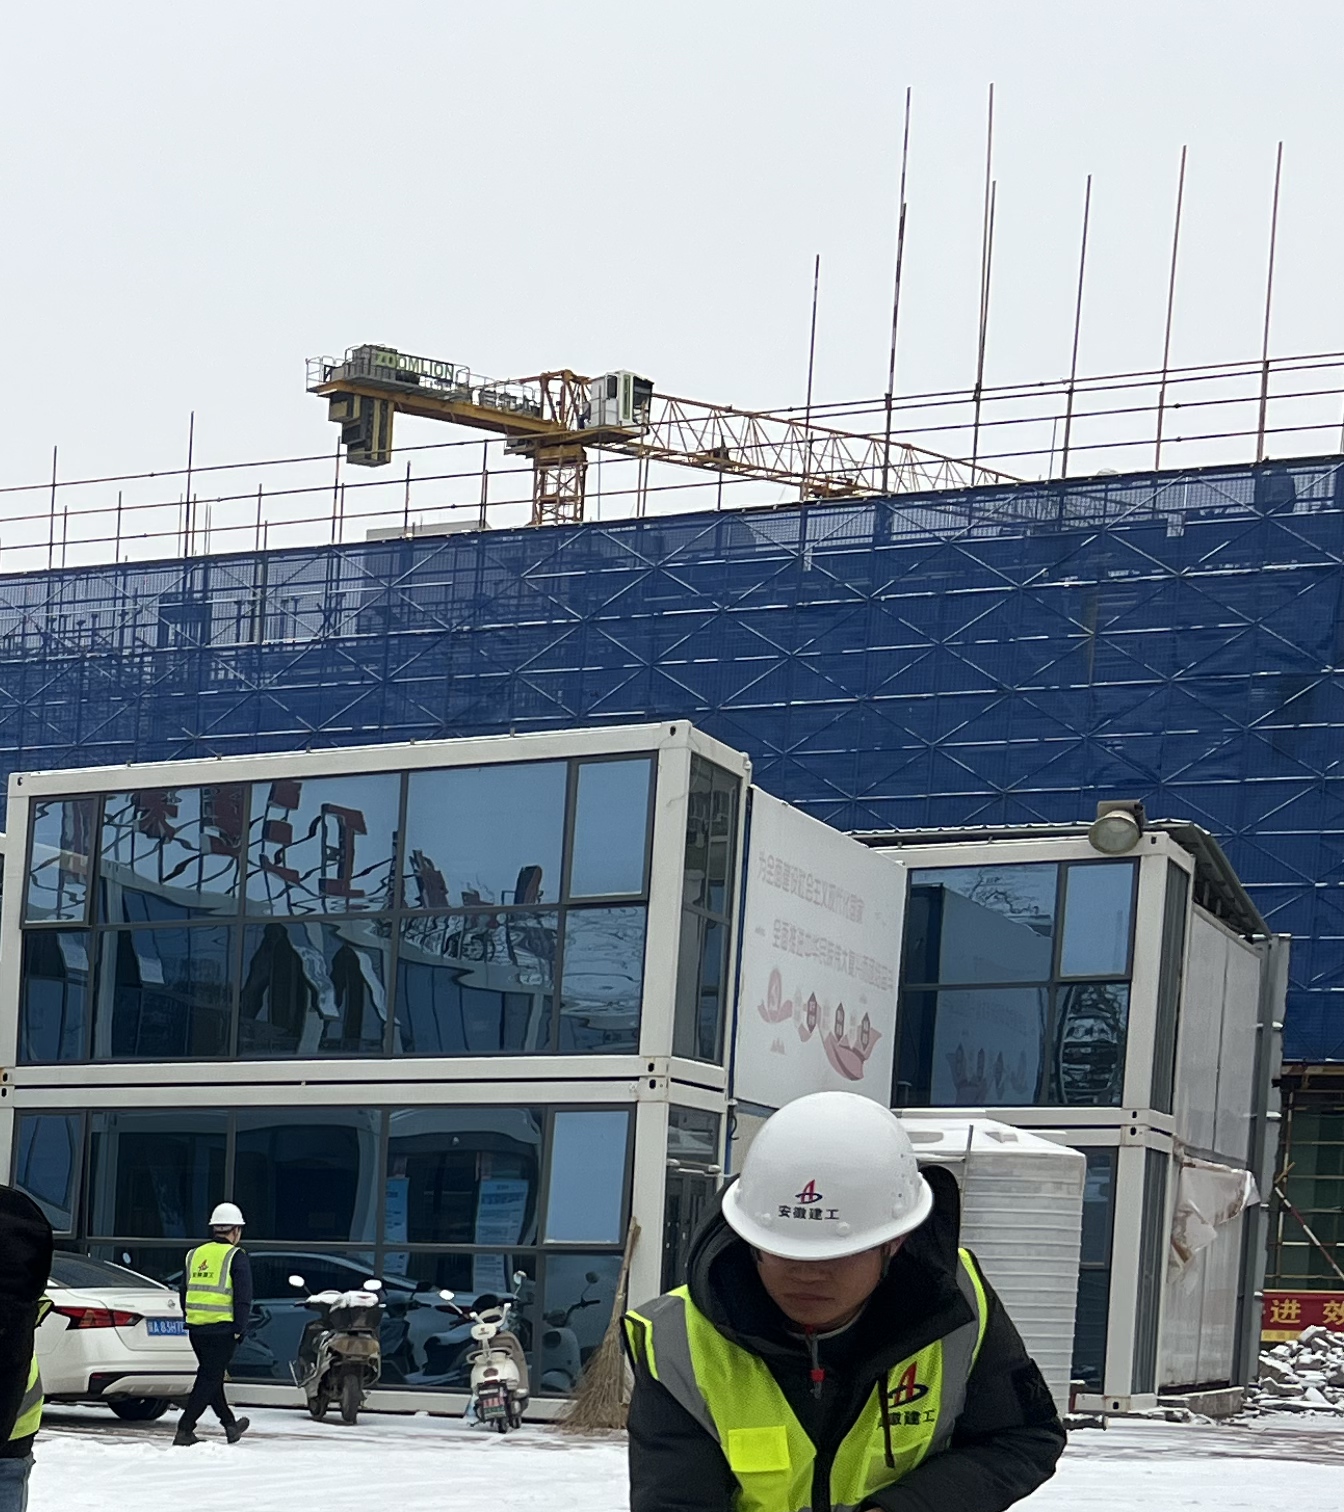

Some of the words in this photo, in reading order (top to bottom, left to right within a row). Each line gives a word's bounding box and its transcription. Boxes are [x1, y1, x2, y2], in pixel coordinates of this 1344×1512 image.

[376, 351, 454, 382] ZOOMLION
[778, 1205, 840, 1221] 安徽建工
[876, 1409, 936, 1430] 徽建工
